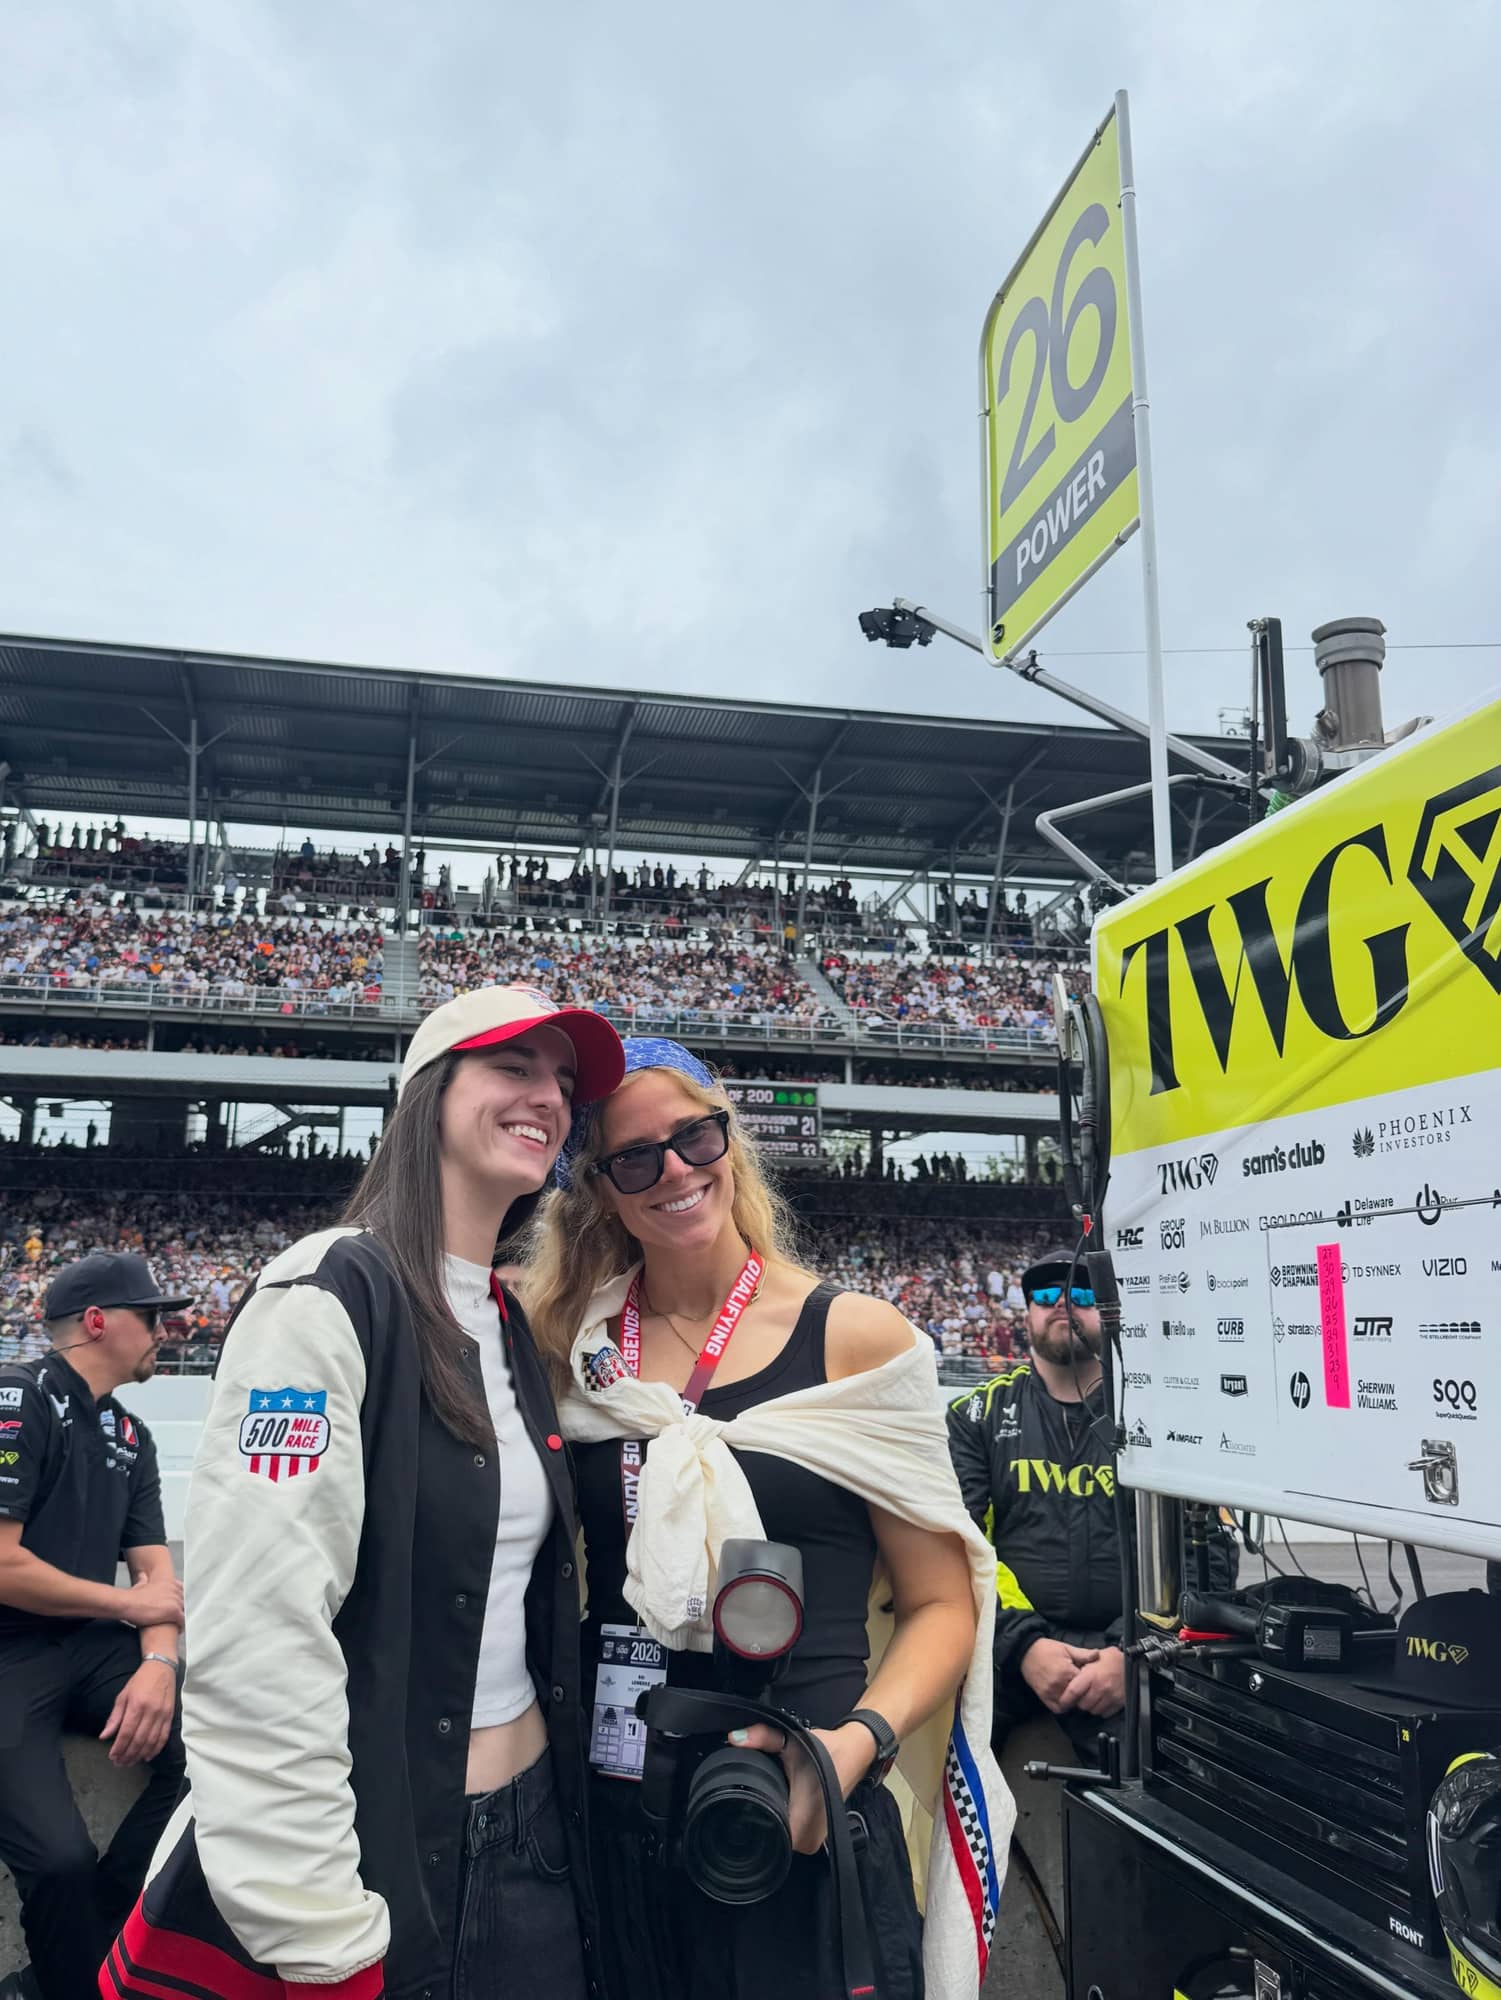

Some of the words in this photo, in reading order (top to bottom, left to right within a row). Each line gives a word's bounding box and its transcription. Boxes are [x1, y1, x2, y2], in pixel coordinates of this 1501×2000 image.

[997, 203, 1117, 519] 26
[1015, 448, 1106, 585] POWER
[1120, 823, 1411, 1096] TWG
[747, 1090, 773, 1103] 200
[801, 1116, 816, 1136] 21
[1379, 1105, 1472, 1138] PHOENIX
[1380, 1131, 1451, 1152] INVESTORS
[1243, 1146, 1287, 1177] sam's
[1288, 1140, 1325, 1169] club
[1157, 1157, 1201, 1194] TWG
[1354, 1197, 1394, 1211] Delaware
[1160, 1218, 1185, 1232] GROUP
[1200, 1221, 1212, 1240] JM
[1213, 1218, 1250, 1235] BULLION
[1160, 1230, 1185, 1250] 1001
[1282, 1264, 1318, 1276] BROWNING
[1352, 1266, 1363, 1278] TD
[1366, 1264, 1401, 1277] SYNNEX
[1422, 1257, 1467, 1277] VIZIO
[1125, 1275, 1150, 1285] YAZAKI
[705, 1259, 760, 1356] QUALIFYING
[1217, 1321, 1244, 1335] CURB
[1291, 1371, 1310, 1408] hp
[1357, 1379, 1395, 1394] SHERWIN
[1433, 1379, 1477, 1411] SQQ
[245, 1418, 290, 1448] 500
[291, 1418, 322, 1433] MILE
[285, 1434, 319, 1448] RACE
[1176, 1433, 1203, 1444] IMPACT
[623, 1441, 640, 1466] 50
[1009, 1459, 1095, 1497] TWG
[623, 1470, 640, 1523] INDY
[630, 1641, 661, 1663] 2026
[1406, 1636, 1448, 1662] TWG
[1389, 1916, 1424, 1948] FRONT
